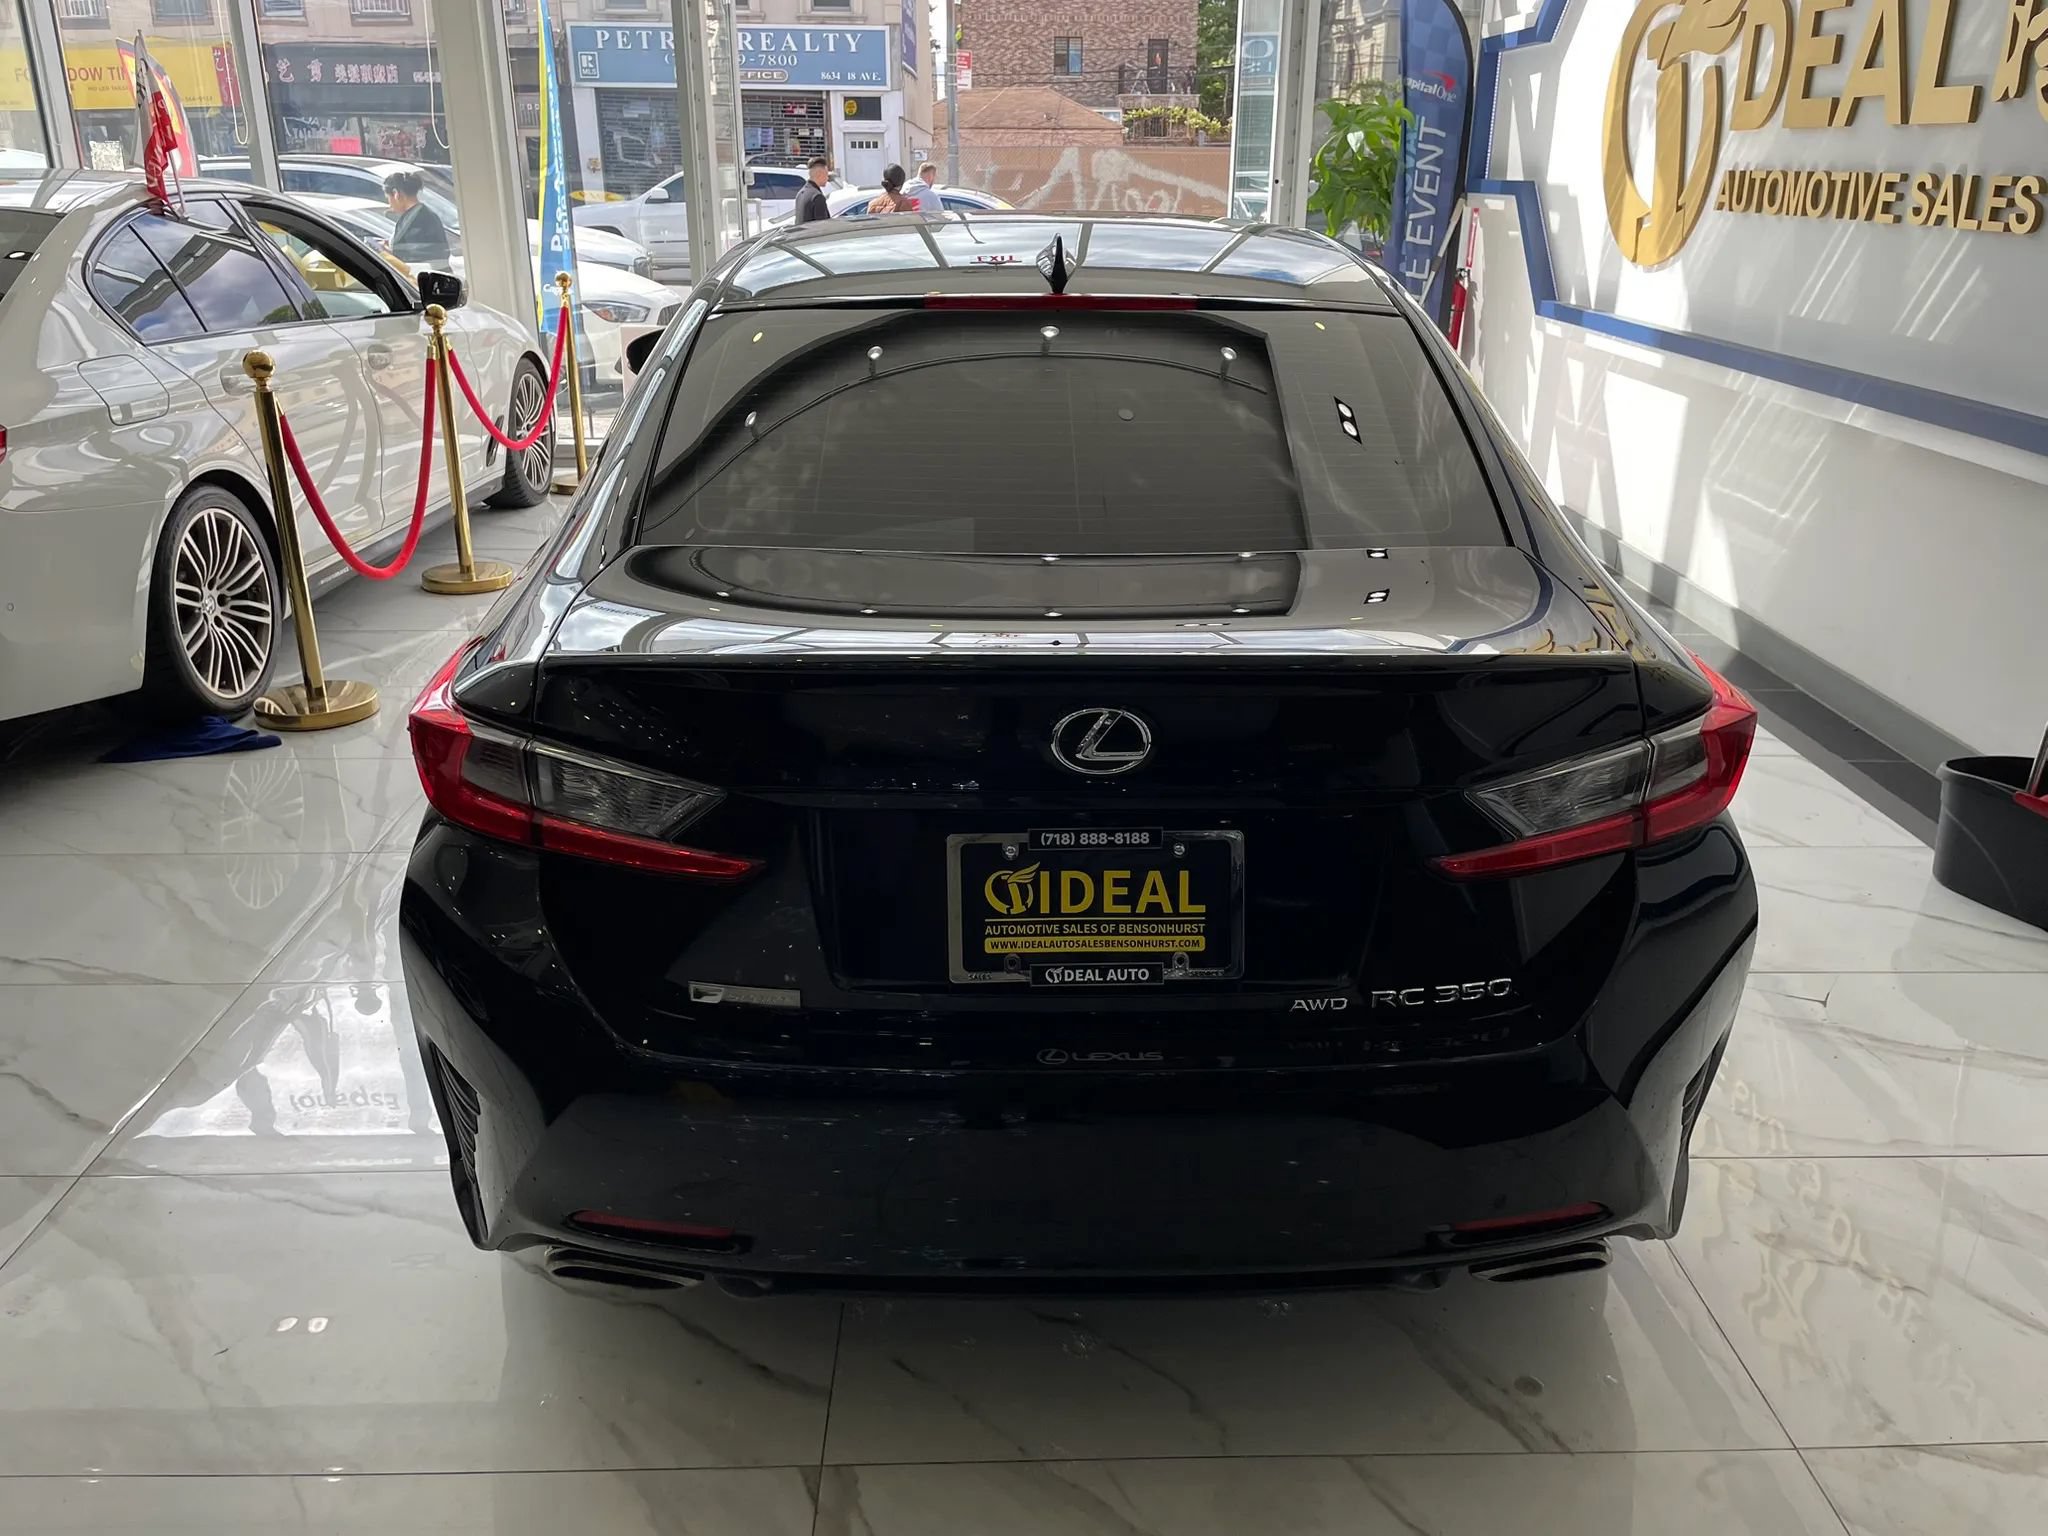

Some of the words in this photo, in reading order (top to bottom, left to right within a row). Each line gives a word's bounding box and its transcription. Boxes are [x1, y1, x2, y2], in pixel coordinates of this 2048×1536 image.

[595, 30, 675, 50] PETR
[737, 31, 863, 53] REALTY
[820, 71, 841, 81] 8634
[1405, 115, 1447, 246] EVENT
[1713, 169, 1906, 225] AUTOMOTIVE
[1907, 172, 2047, 236] SALES
[1040, 831, 1076, 846] (718)
[1079, 831, 1151, 845] 888-8188
[1040, 870, 1207, 914] IDEAL
[985, 924, 1060, 936] AUTOMOTIVE
[1063, 924, 1098, 935] SALES
[1100, 923, 1117, 934] OF
[1118, 922, 1206, 935] BENSONHURST
[990, 938, 1201, 950] WWW.IDEALAUTOSALESBENSONHURST.COM
[1106, 968, 1150, 982] AUTO
[1289, 997, 1349, 1012] AWD
[1371, 987, 1425, 1008] RC
[1433, 978, 1512, 1003] 350
[1071, 1051, 1164, 1061] LEXUS
